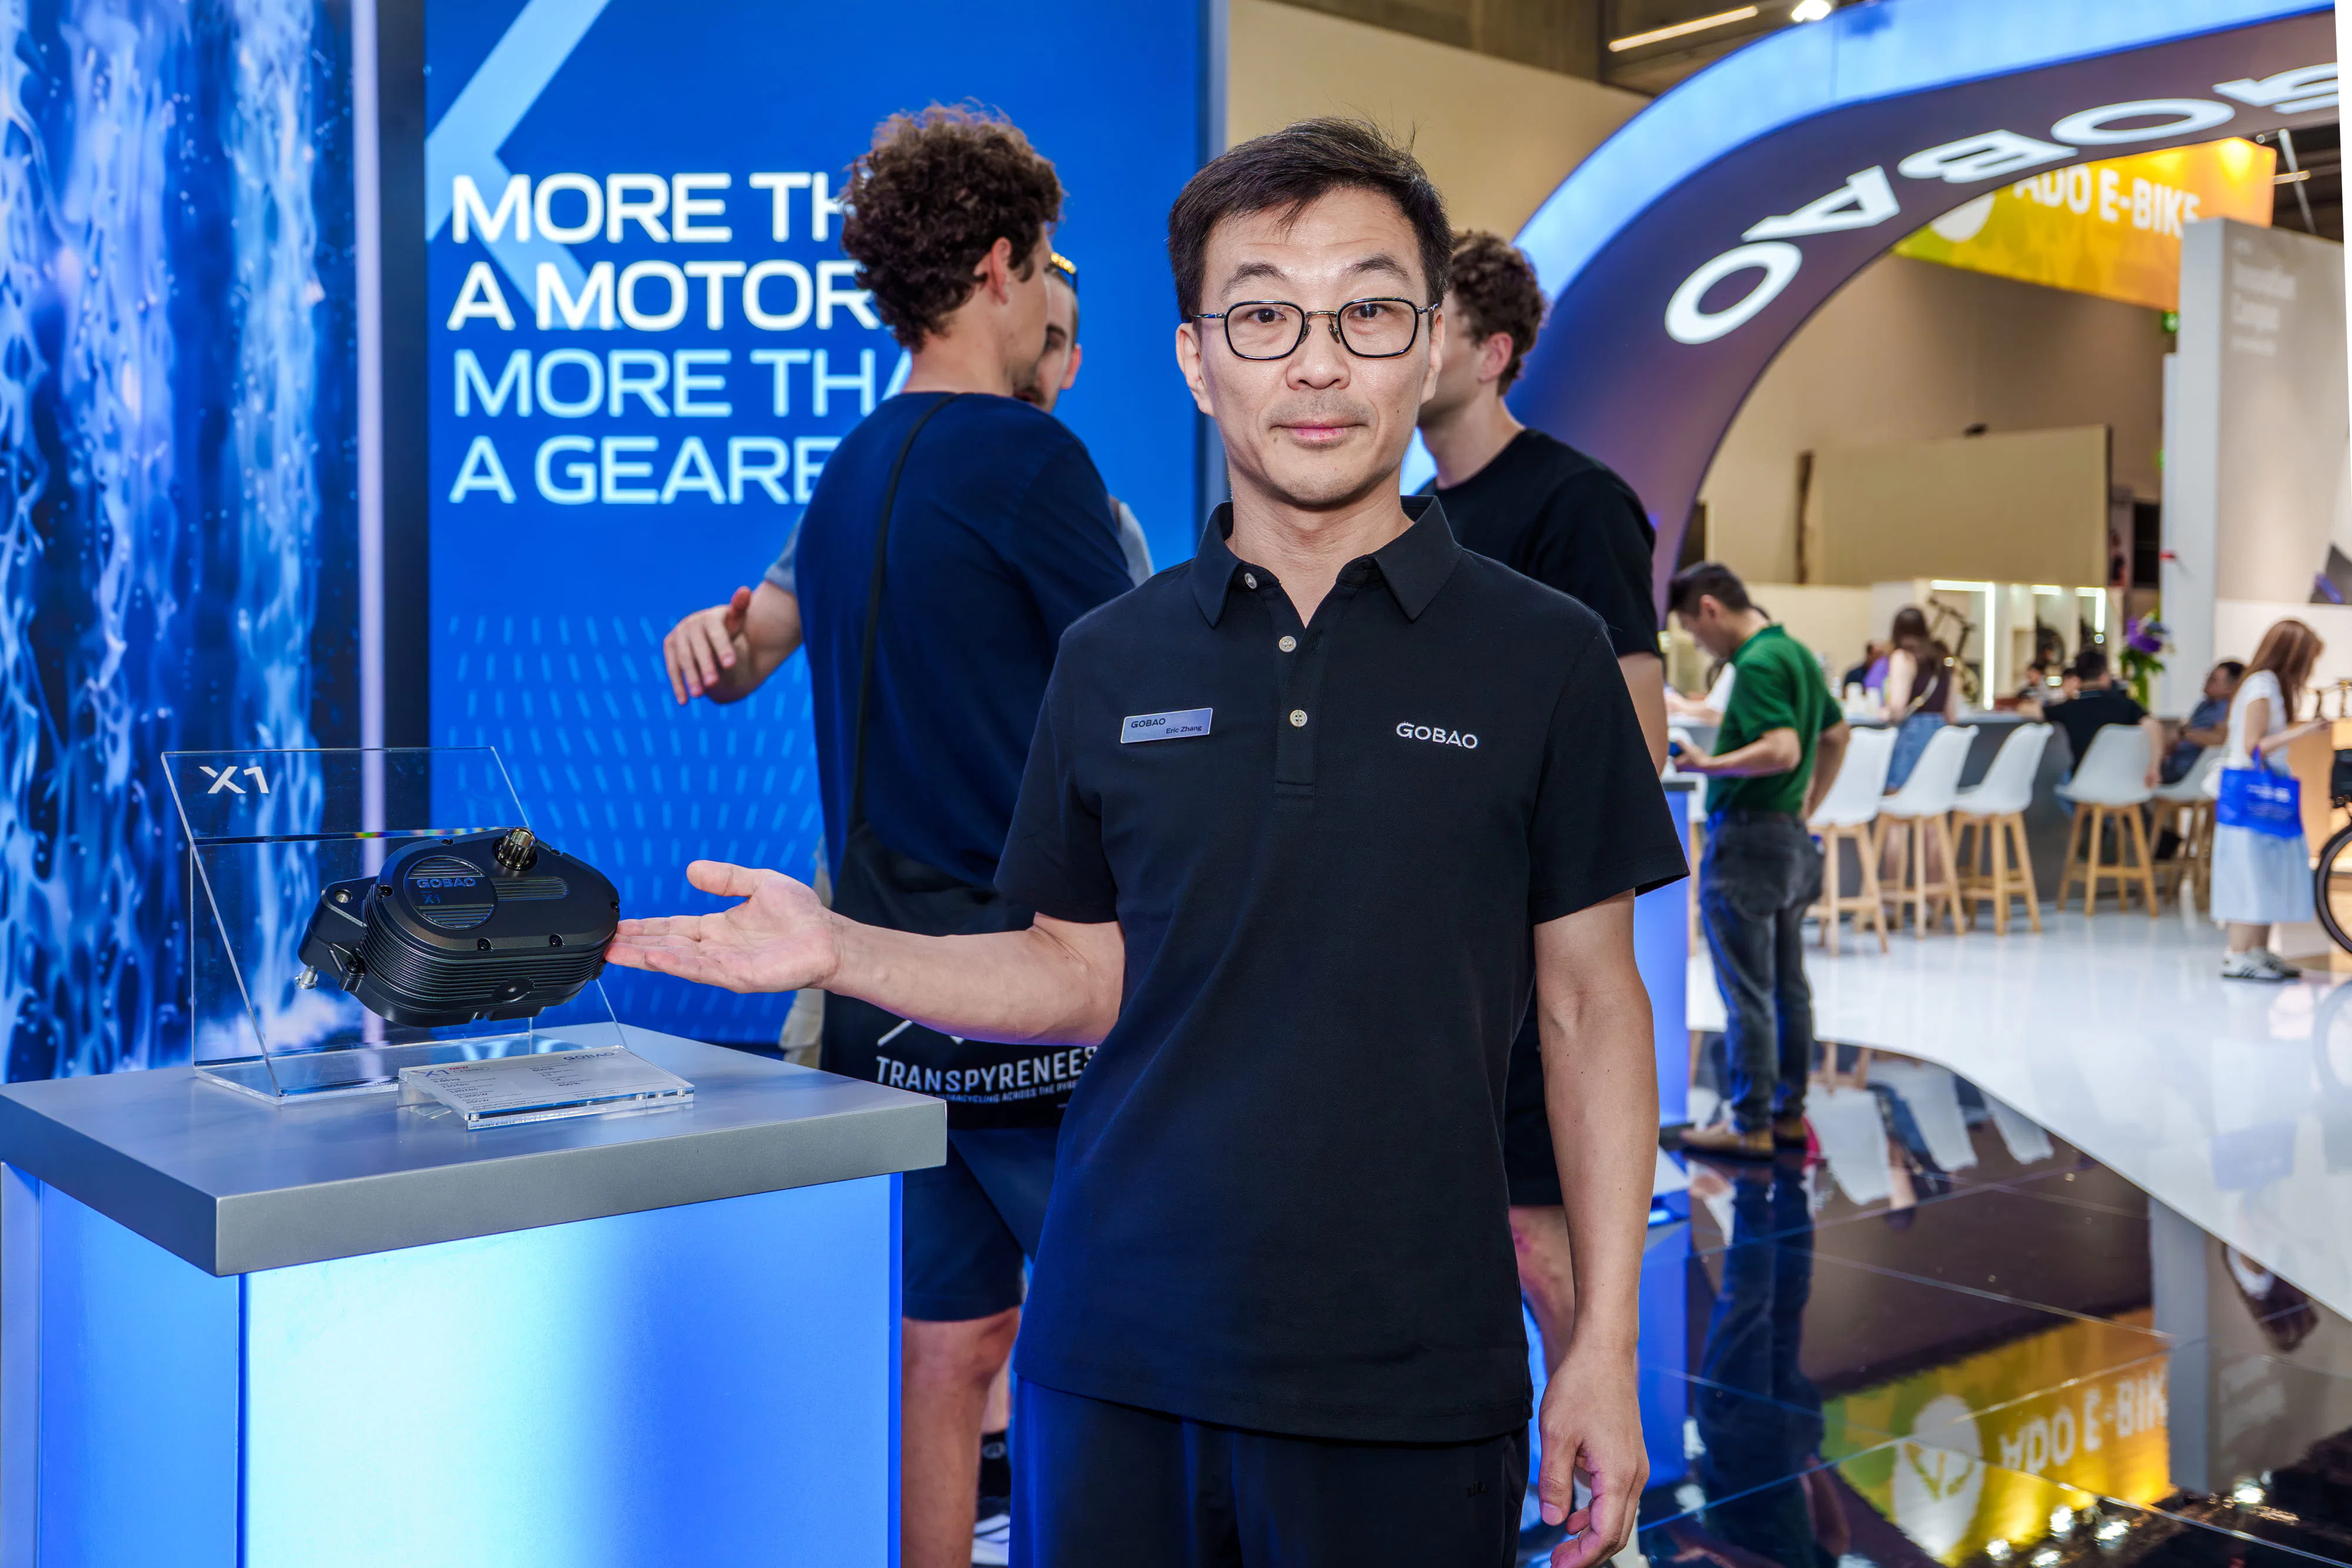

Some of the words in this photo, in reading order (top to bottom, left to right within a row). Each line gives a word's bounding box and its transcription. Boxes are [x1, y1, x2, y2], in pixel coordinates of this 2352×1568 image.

[453, 173, 732, 243] MORE
[749, 172, 856, 243] TH
[2099, 168, 2201, 239] E-BIKE
[447, 260, 516, 331] A
[536, 260, 880, 331] MOTOR
[454, 348, 732, 418] MORE
[750, 347, 912, 418] TH
[448, 435, 516, 504] A
[534, 434, 843, 505] GEARE
[1131, 718, 1165, 728] GOBAO
[1395, 721, 1478, 749] GOBAO
[199, 765, 270, 794] X1
[416, 877, 476, 888] GOBAO
[421, 894, 441, 904] X1
[563, 1052, 614, 1061] GOBAO
[419, 1069, 450, 1077] X1
